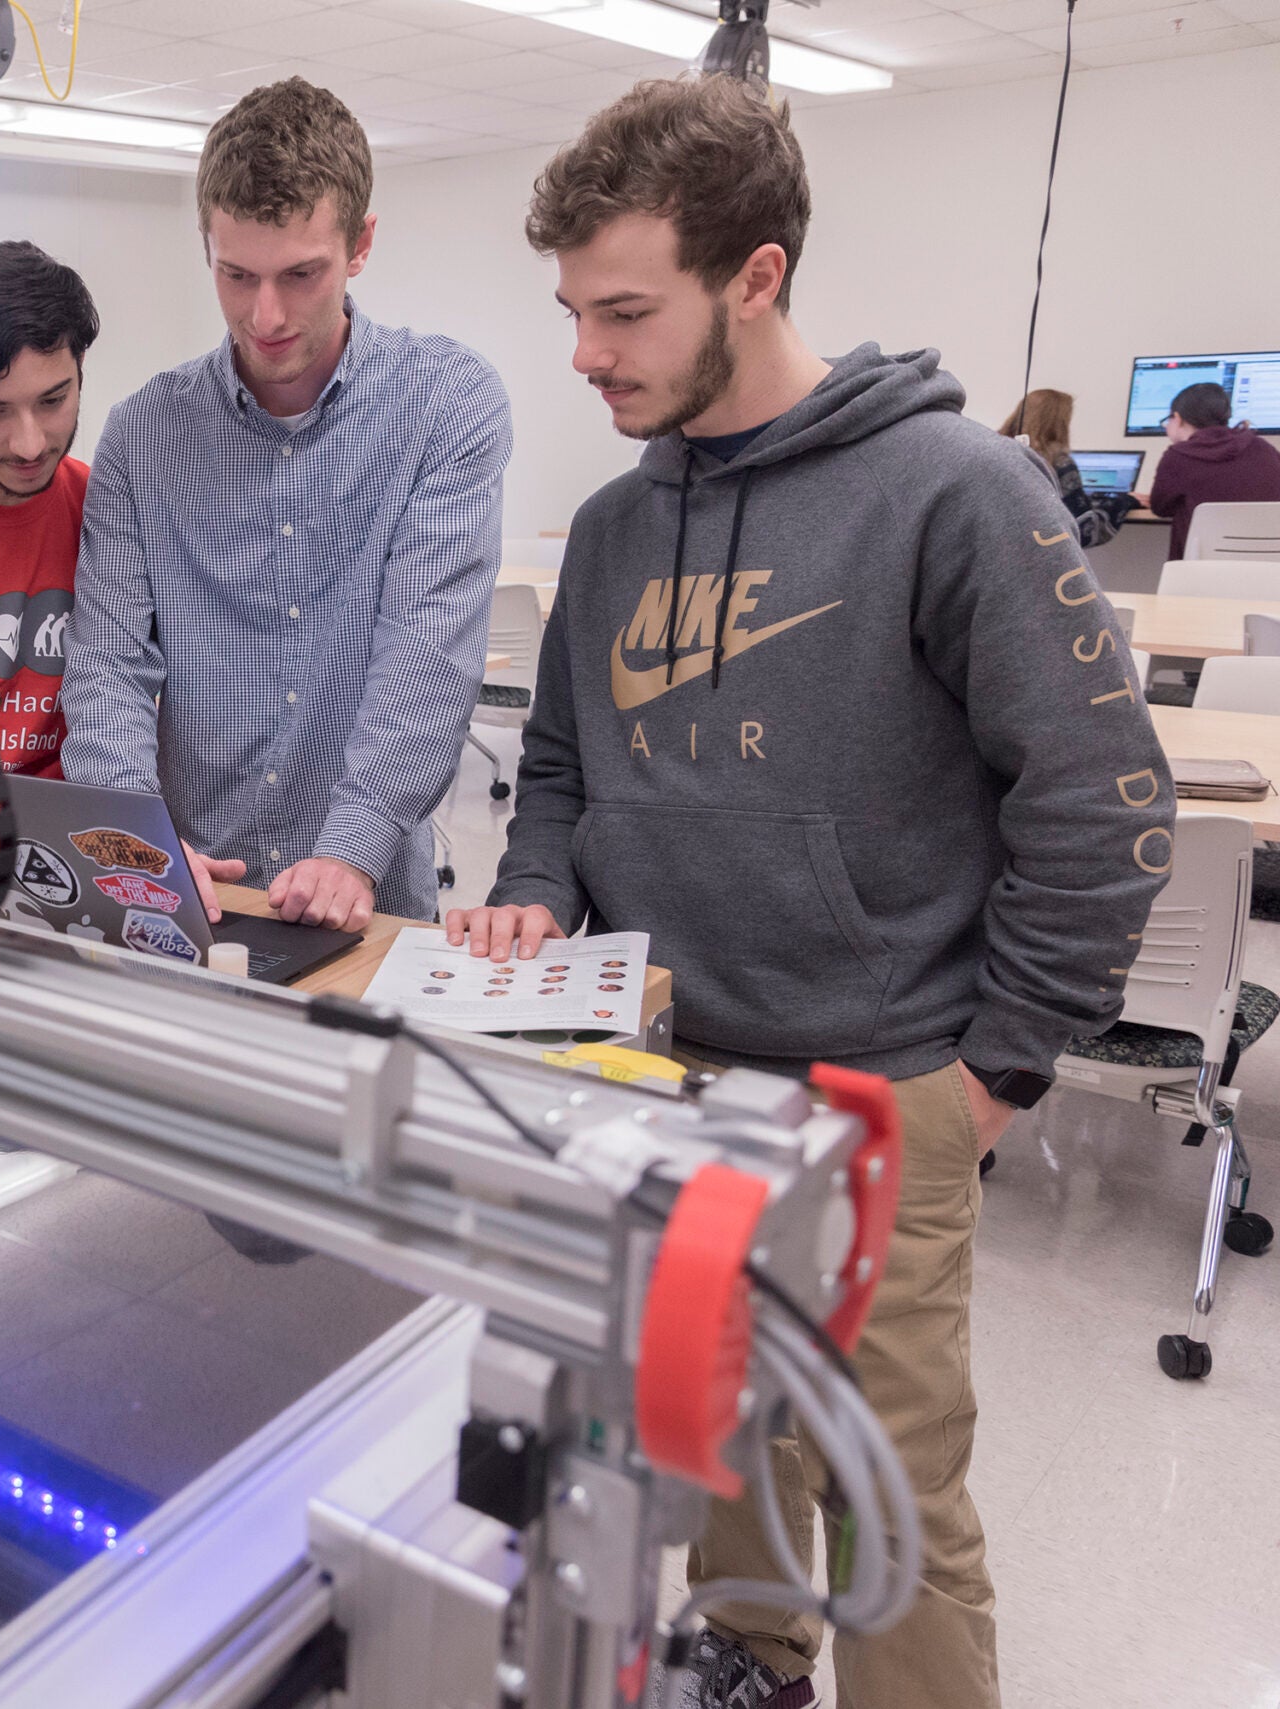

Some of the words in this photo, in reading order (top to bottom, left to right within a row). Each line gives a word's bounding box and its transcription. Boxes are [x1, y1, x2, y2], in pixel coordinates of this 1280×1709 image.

[624, 570, 774, 650] NIKE
[1033, 530, 1136, 705] JUST
[1116, 768, 1174, 874] DO
[0, 727, 59, 751] Island
[630, 720, 767, 761] AIR
[96, 833, 131, 848] VANS
[105, 845, 131, 863] THE
[116, 876, 148, 890] VANS
[124, 887, 148, 903] THE
[129, 913, 175, 936] Good
